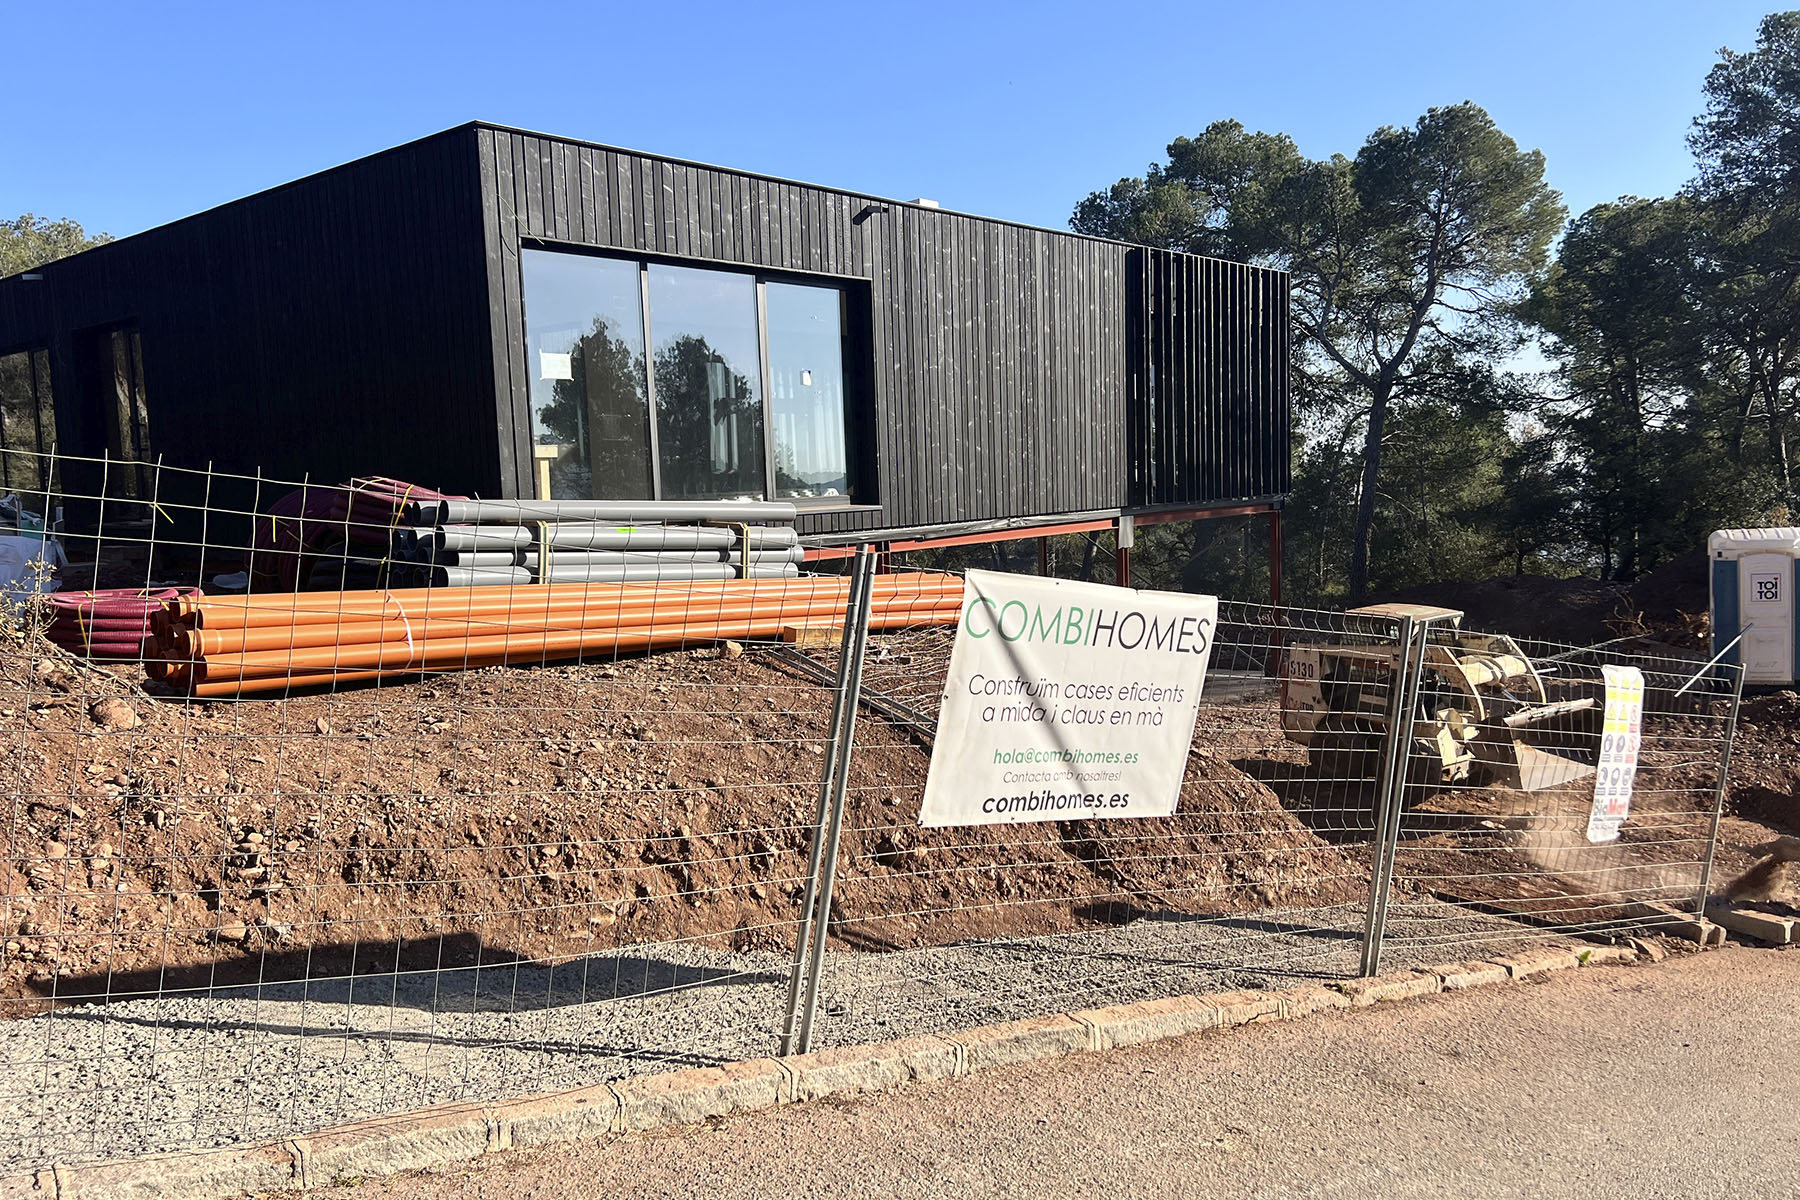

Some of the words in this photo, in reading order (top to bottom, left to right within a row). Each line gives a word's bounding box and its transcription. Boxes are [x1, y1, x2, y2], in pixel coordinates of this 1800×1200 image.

[1757, 580, 1778, 590] TOI
[1757, 590, 1778, 600] TOI
[966, 597, 1210, 654] COMBIHOMES
[1290, 660, 1314, 678] S130
[969, 674, 1059, 698] Construïm
[1064, 683, 1114, 700] cases
[1118, 681, 1184, 703] eficients
[982, 706, 995, 722] a
[1000, 701, 1047, 722] mida
[1051, 704, 1058, 723] i
[1061, 704, 1106, 725] claus
[1110, 710, 1132, 725] en
[1136, 706, 1163, 726] mà
[993, 748, 1139, 765] hola@combihomes.es
[1003, 771, 1051, 784] Contacta
[1076, 771, 1122, 782] nosaltres!
[982, 790, 1129, 814] combihomes.es
